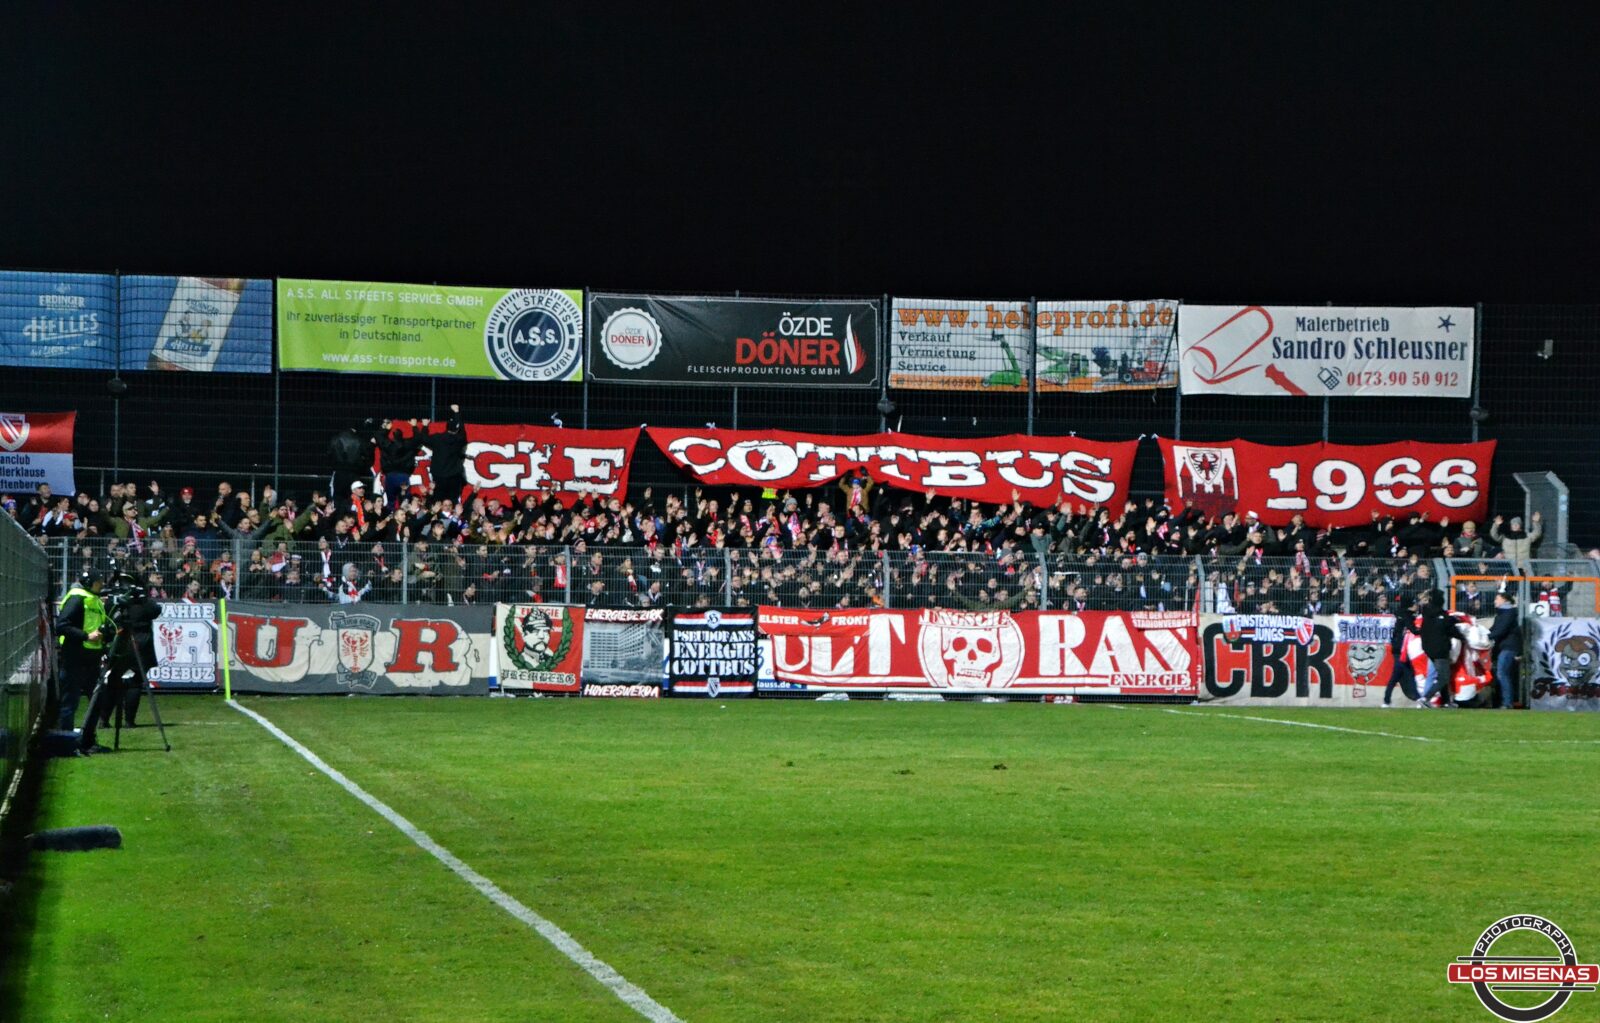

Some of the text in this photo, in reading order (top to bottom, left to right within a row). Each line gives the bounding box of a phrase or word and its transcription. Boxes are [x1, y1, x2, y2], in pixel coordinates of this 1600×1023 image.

[39, 295, 85, 307] ERDINGER
[286, 287, 484, 306] A.S.S. ALL STREETS SERVICE GMBH
[502, 296, 572, 324] ALL STREETS
[23, 313, 99, 342] HELLES
[286, 310, 477, 330] Ihr zuverlässiger Transportpartner
[778, 311, 834, 336] ÖZDE
[1295, 316, 1390, 332] Malerbetrieb
[338, 328, 349, 340] in
[514, 326, 559, 346] A.S.S.
[610, 332, 645, 345] DÖNER
[897, 331, 952, 344] Verkauf
[735, 331, 841, 366] DÖNER
[897, 345, 977, 361] Vermietung
[1272, 336, 1468, 362] Sandro Schleusner
[321, 352, 457, 368] www.ass-transporte.de
[500, 350, 572, 379] SERVICE GMBH
[897, 361, 947, 373] Service
[687, 365, 841, 376] FLEISCHPRODUKTIONS GMBH
[1346, 371, 1459, 387] 0173.90 50 912
[667, 436, 1116, 503] COTTBUS
[1265, 456, 1480, 511] 1966
[160, 603, 215, 619] AHRE
[758, 614, 869, 626] ELSTER FRONT
[673, 630, 755, 641] PSEUDOFANS
[1252, 628, 1285, 641] JUNGS
[673, 642, 756, 659] ENERGIE
[672, 659, 756, 676] COTTBUS
[1203, 622, 1336, 699] CBR
[757, 681, 791, 689] lauss.de
[1108, 672, 1190, 687] ENERGIE
[584, 684, 660, 698] HOYERSWERDA
